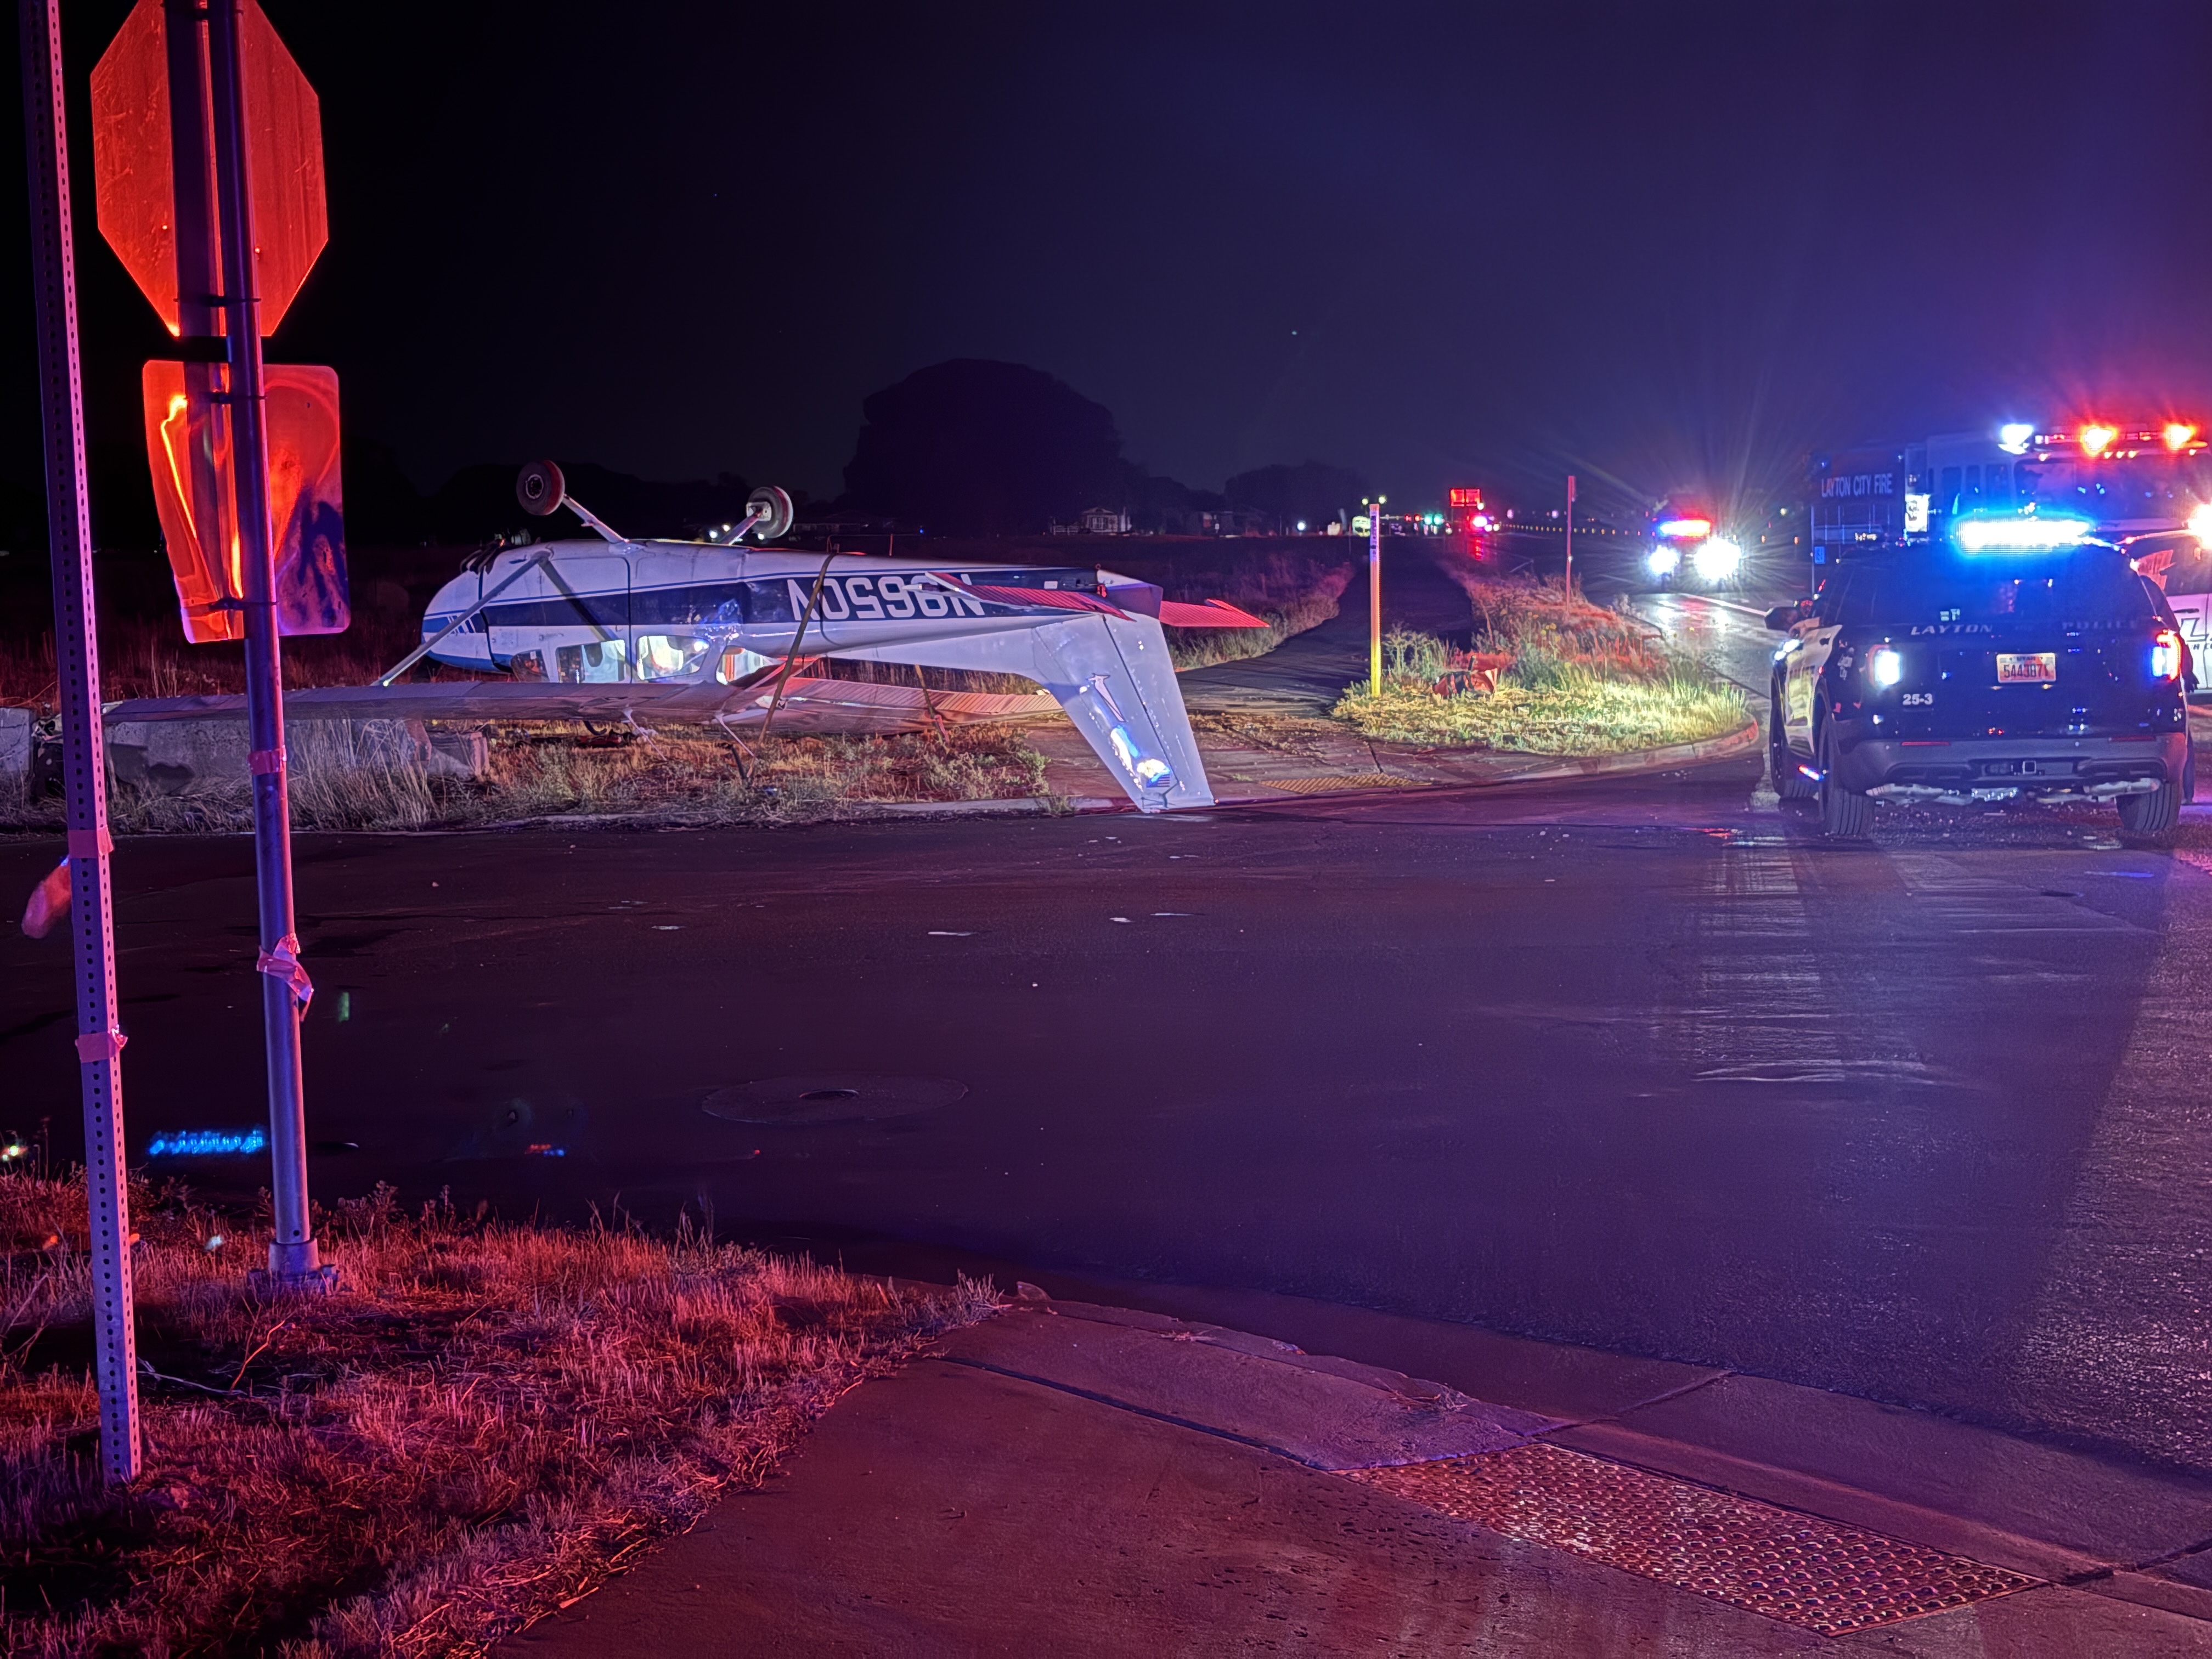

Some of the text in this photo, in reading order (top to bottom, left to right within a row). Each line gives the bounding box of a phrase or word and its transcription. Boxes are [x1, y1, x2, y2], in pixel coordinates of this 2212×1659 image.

[1821, 473, 1893, 498] LAYTON CITY FIRE
[1911, 624, 1993, 635] LAYTON
[1903, 693, 1933, 706] 25-3
